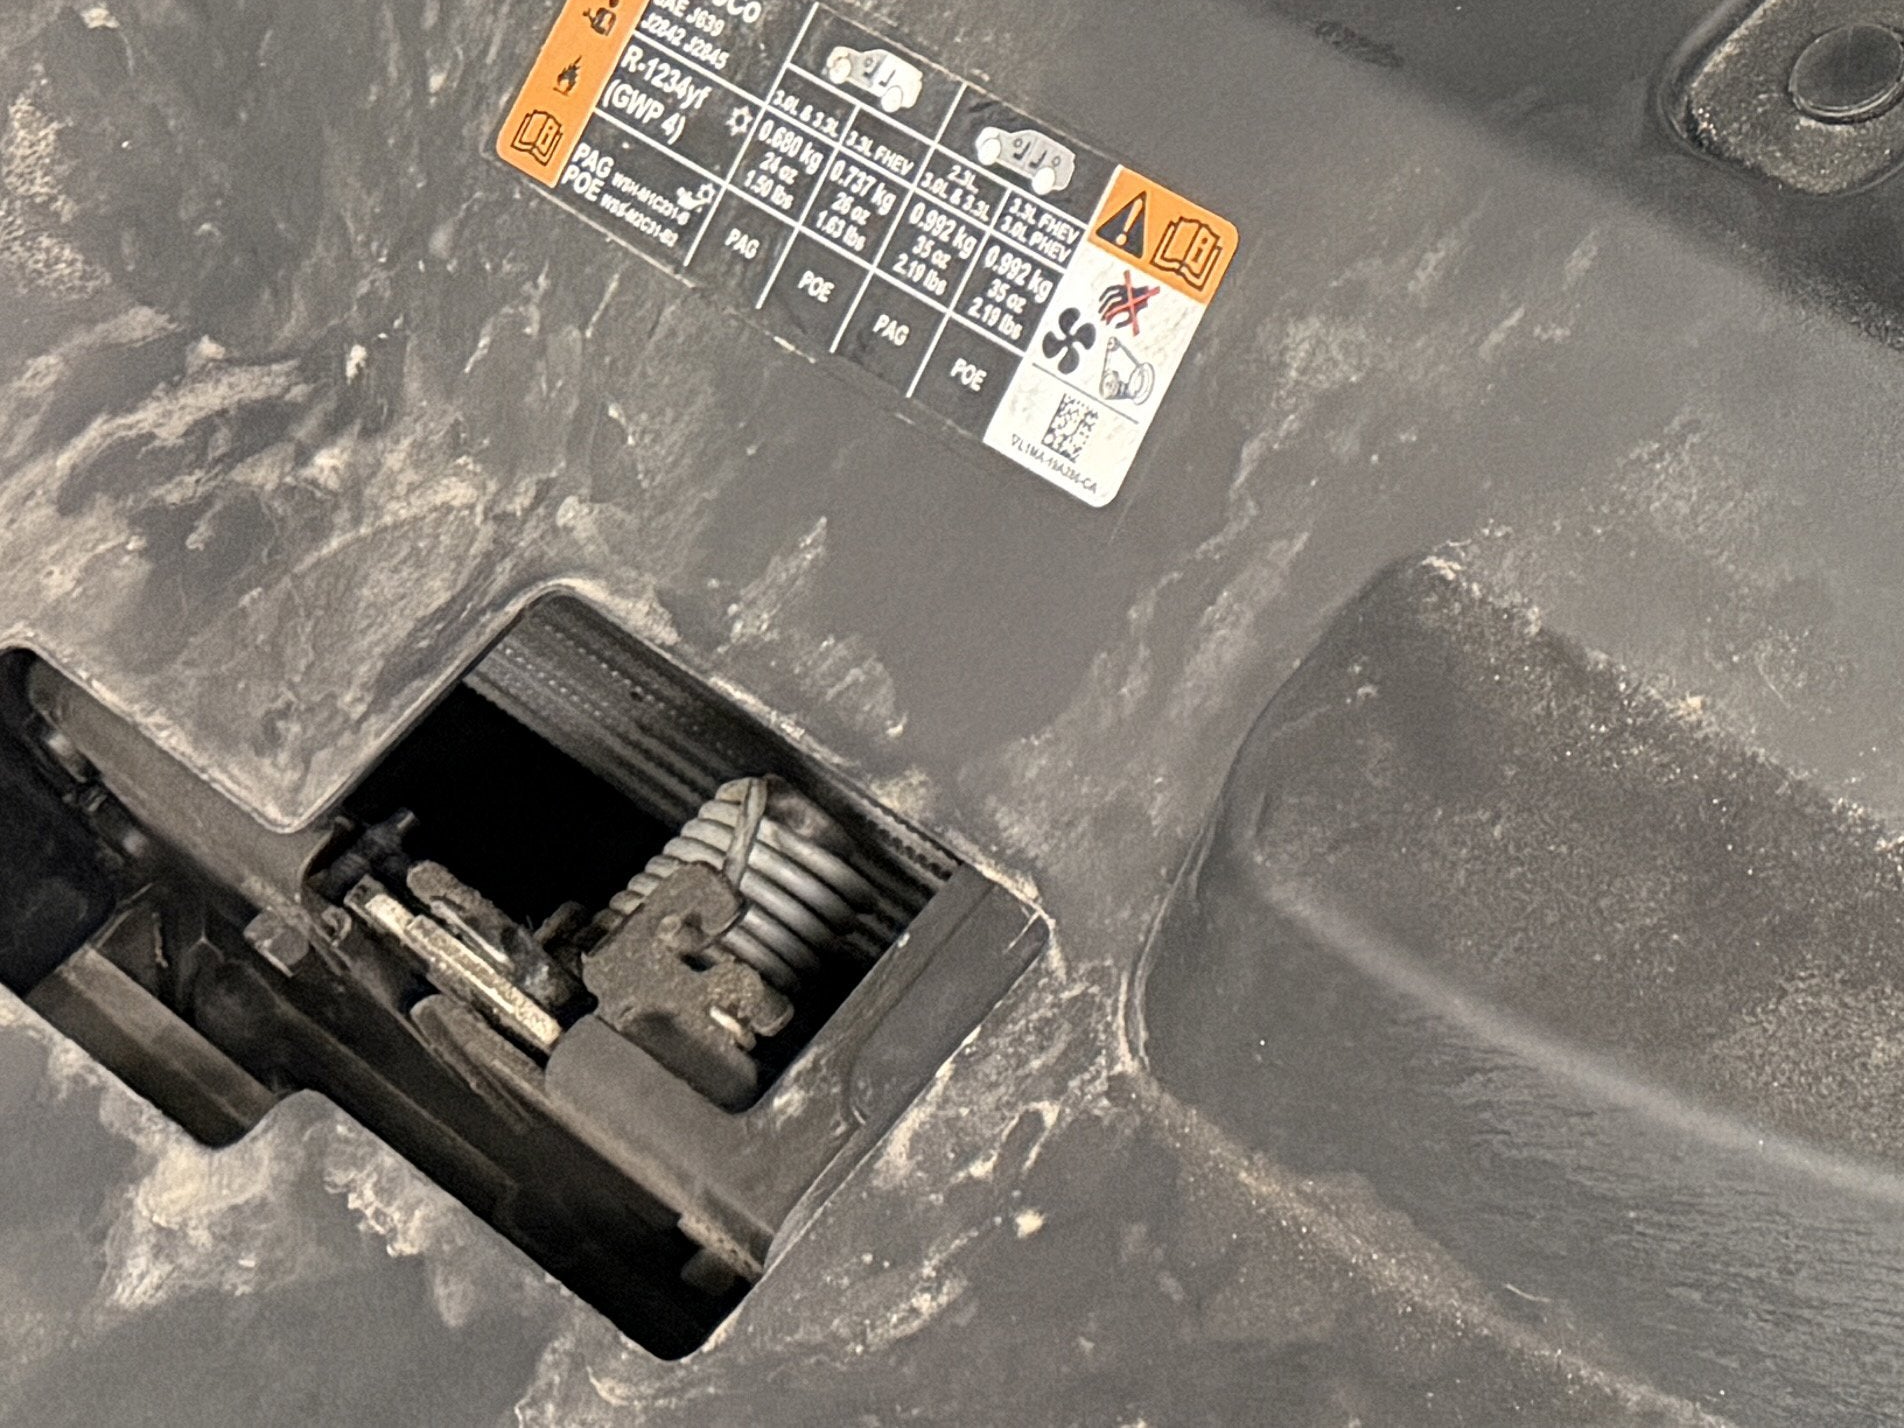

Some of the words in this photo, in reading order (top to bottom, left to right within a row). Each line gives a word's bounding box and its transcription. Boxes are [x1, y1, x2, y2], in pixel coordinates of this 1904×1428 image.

[620, 44, 713, 110] R-1234yf
[602, 78, 665, 124] (GWP
[571, 142, 615, 179] PAG
[778, 165, 799, 185] oz
[798, 141, 824, 176] kg
[873, 144, 915, 176] FHEV
[560, 164, 605, 202] POE
[769, 183, 794, 210] lbs
[829, 159, 877, 198] 0.737
[870, 182, 897, 216] kg
[850, 205, 871, 226] oz
[908, 201, 957, 243] 0.992
[951, 225, 978, 260] kg
[1037, 212, 1081, 245] FHEV
[724, 227, 760, 260] PAG
[842, 224, 867, 252] lbs
[911, 234, 936, 259] 35
[930, 249, 952, 270] oz
[1027, 230, 1072, 263] PHEV
[797, 270, 835, 303] POE
[892, 252, 927, 283] 2.19
[922, 268, 948, 296] lbs
[983, 244, 1033, 287] 0.992
[1026, 268, 1054, 304] kg
[986, 278, 1011, 303] 35
[1005, 293, 1027, 314] oz
[872, 313, 910, 346] PAG
[966, 296, 1006, 327] 2.19
[997, 312, 1023, 341] lbs
[949, 357, 987, 392] POE
